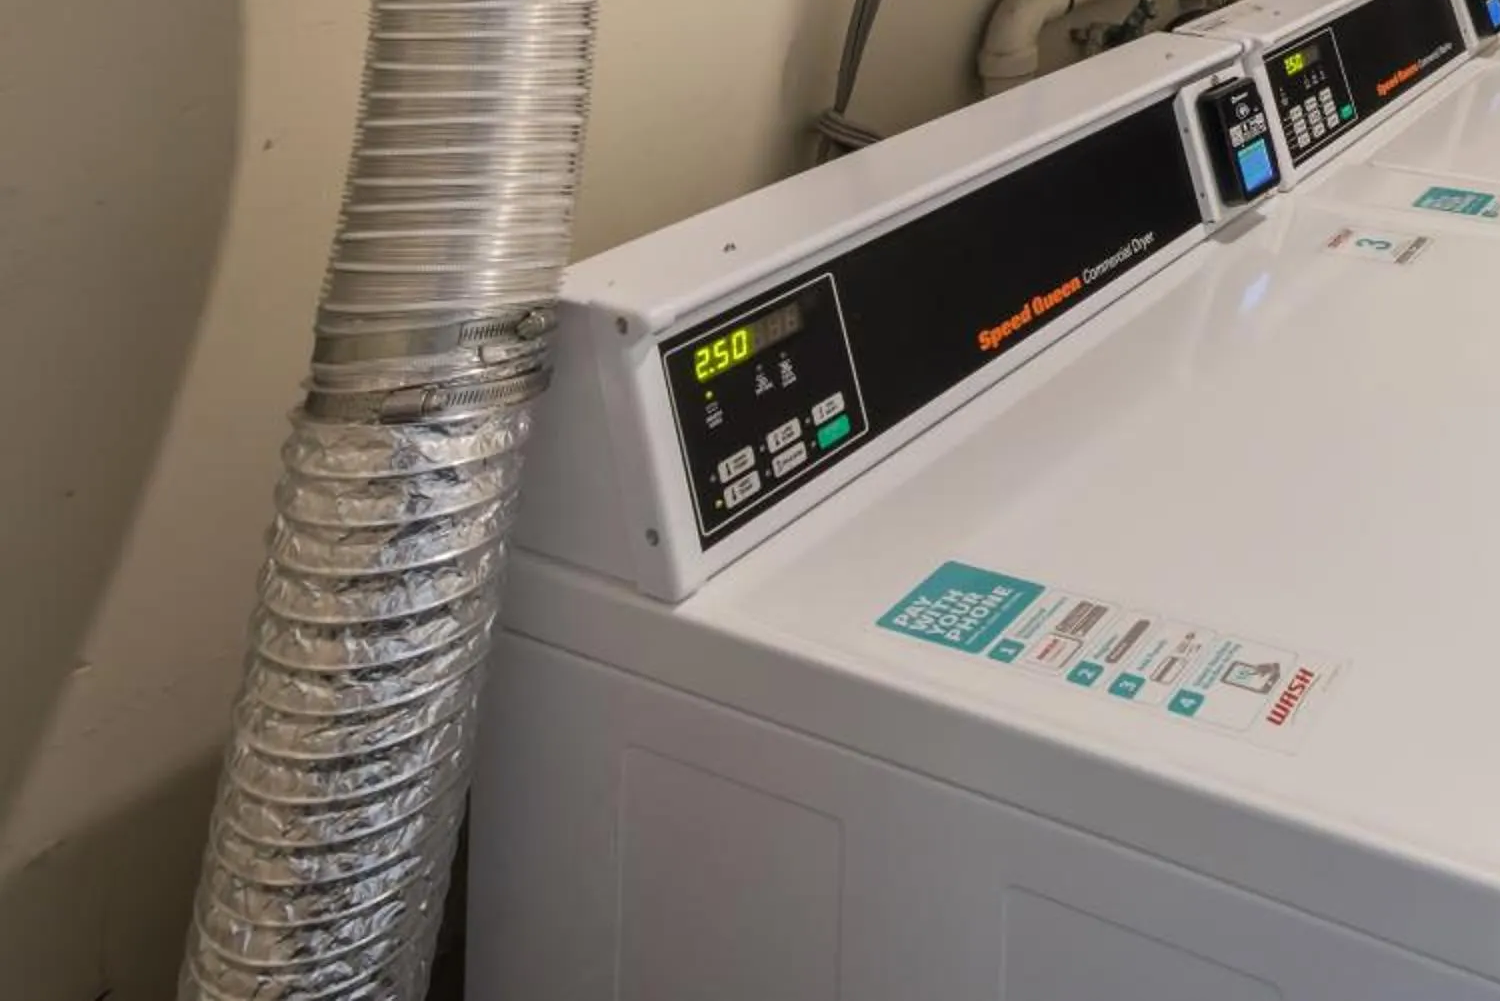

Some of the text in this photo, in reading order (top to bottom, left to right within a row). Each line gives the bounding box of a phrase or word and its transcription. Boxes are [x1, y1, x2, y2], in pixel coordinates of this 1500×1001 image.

[1355, 237, 1391, 251] 3
[978, 231, 1156, 351] Speed Queen Commercial Dryer
[694, 329, 749, 380] 2.50
[893, 595, 932, 627] PAY
[908, 588, 963, 631] WITH
[926, 591, 984, 636] YOUR
[944, 584, 1014, 642] PHONE
[1076, 668, 1095, 680] 2
[1118, 679, 1138, 692] 3
[1266, 666, 1316, 727] WASH
